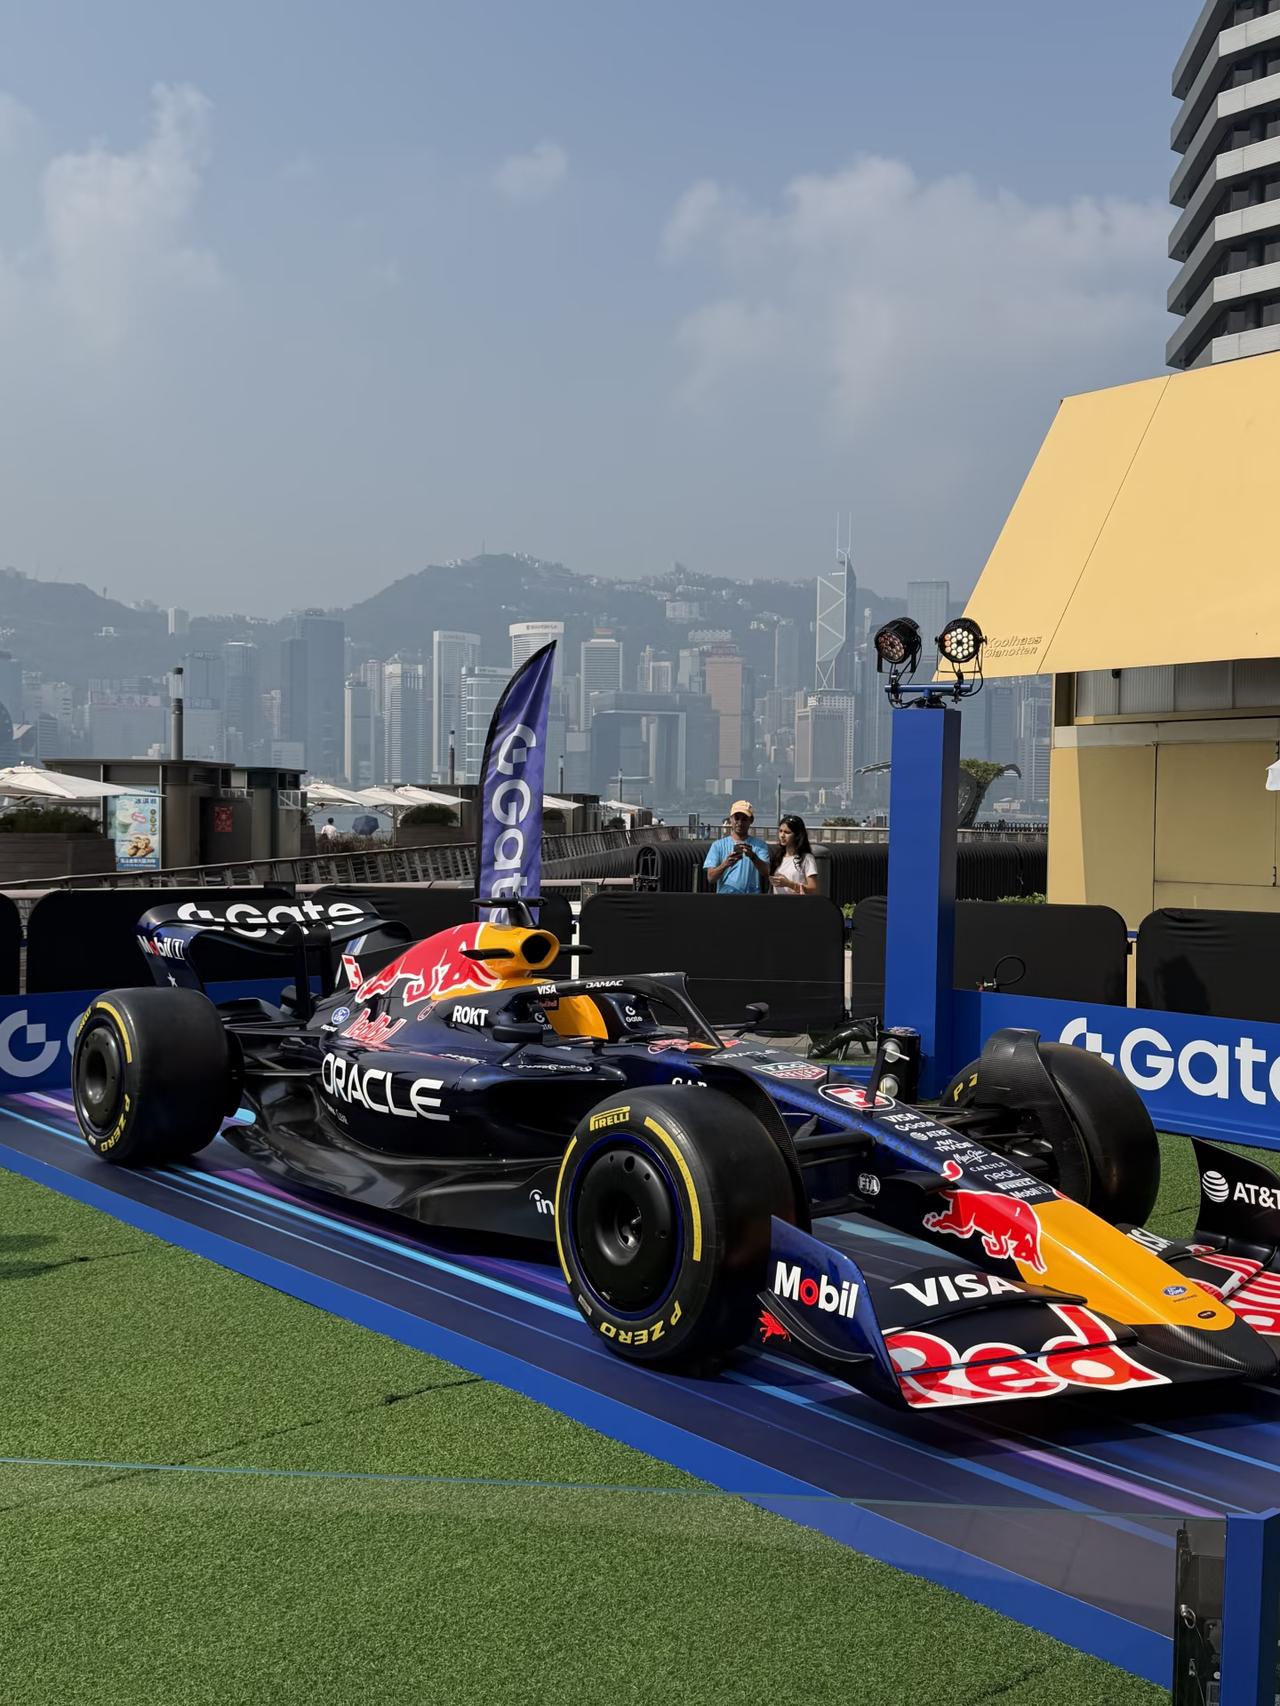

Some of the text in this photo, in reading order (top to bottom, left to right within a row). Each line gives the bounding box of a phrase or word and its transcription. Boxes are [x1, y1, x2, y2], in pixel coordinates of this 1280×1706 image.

[137, 935, 174, 957] Mobil
[537, 984, 558, 995] VISA
[586, 980, 624, 989] DAMAC
[452, 1005, 488, 1027] ROKT
[1120, 1027, 1280, 1106] Gat
[321, 1052, 450, 1121] ORACLE
[589, 1106, 631, 1132] PIRELLI
[880, 1113, 920, 1123] VISA
[925, 1129, 952, 1138] AT&T
[969, 1162, 1008, 1172] CARLYLE
[859, 1177, 879, 1192] FIA
[1009, 1187, 1041, 1199] Mobil
[1233, 1181, 1280, 1210] AT&T
[1126, 1227, 1175, 1254] ISA
[774, 1261, 859, 1319] Mobil
[890, 1273, 1026, 1307] VISA
[600, 1320, 666, 1346] ZERO
[881, 1302, 1173, 1409] Red
